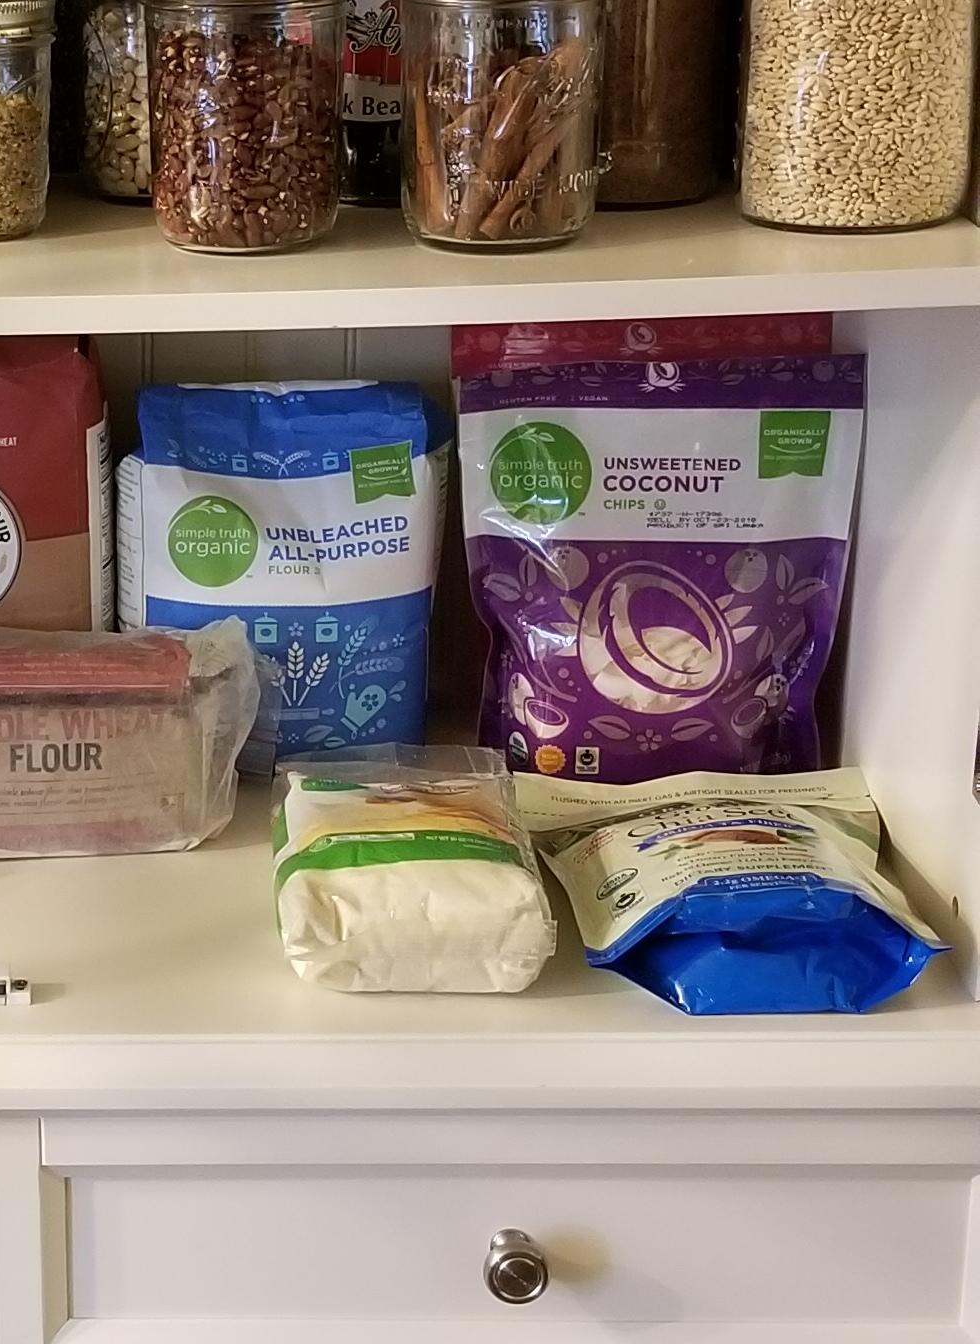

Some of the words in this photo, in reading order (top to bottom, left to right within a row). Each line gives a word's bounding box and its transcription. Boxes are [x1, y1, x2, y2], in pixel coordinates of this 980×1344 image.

[579, 394, 609, 402] VEGAN
[763, 428, 826, 437] ORGANICALLY
[778, 436, 813, 445] GROWN
[498, 459, 545, 475] simple
[547, 458, 583, 472] truth
[604, 457, 741, 472] UNSWEETENED
[500, 471, 583, 490] organic
[603, 475, 725, 493] COCONUT
[604, 498, 646, 511] CHIPS
[175, 527, 217, 542] simple
[220, 527, 251, 539] truth
[266, 516, 408, 544] UNBLEACHED
[175, 539, 251, 557] organic
[269, 537, 411, 563] ALL-PURPOSE
[268, 565, 310, 575] FLOUR
[58, 711, 168, 741] WHEAT
[9, 742, 103, 774] FLOUR
